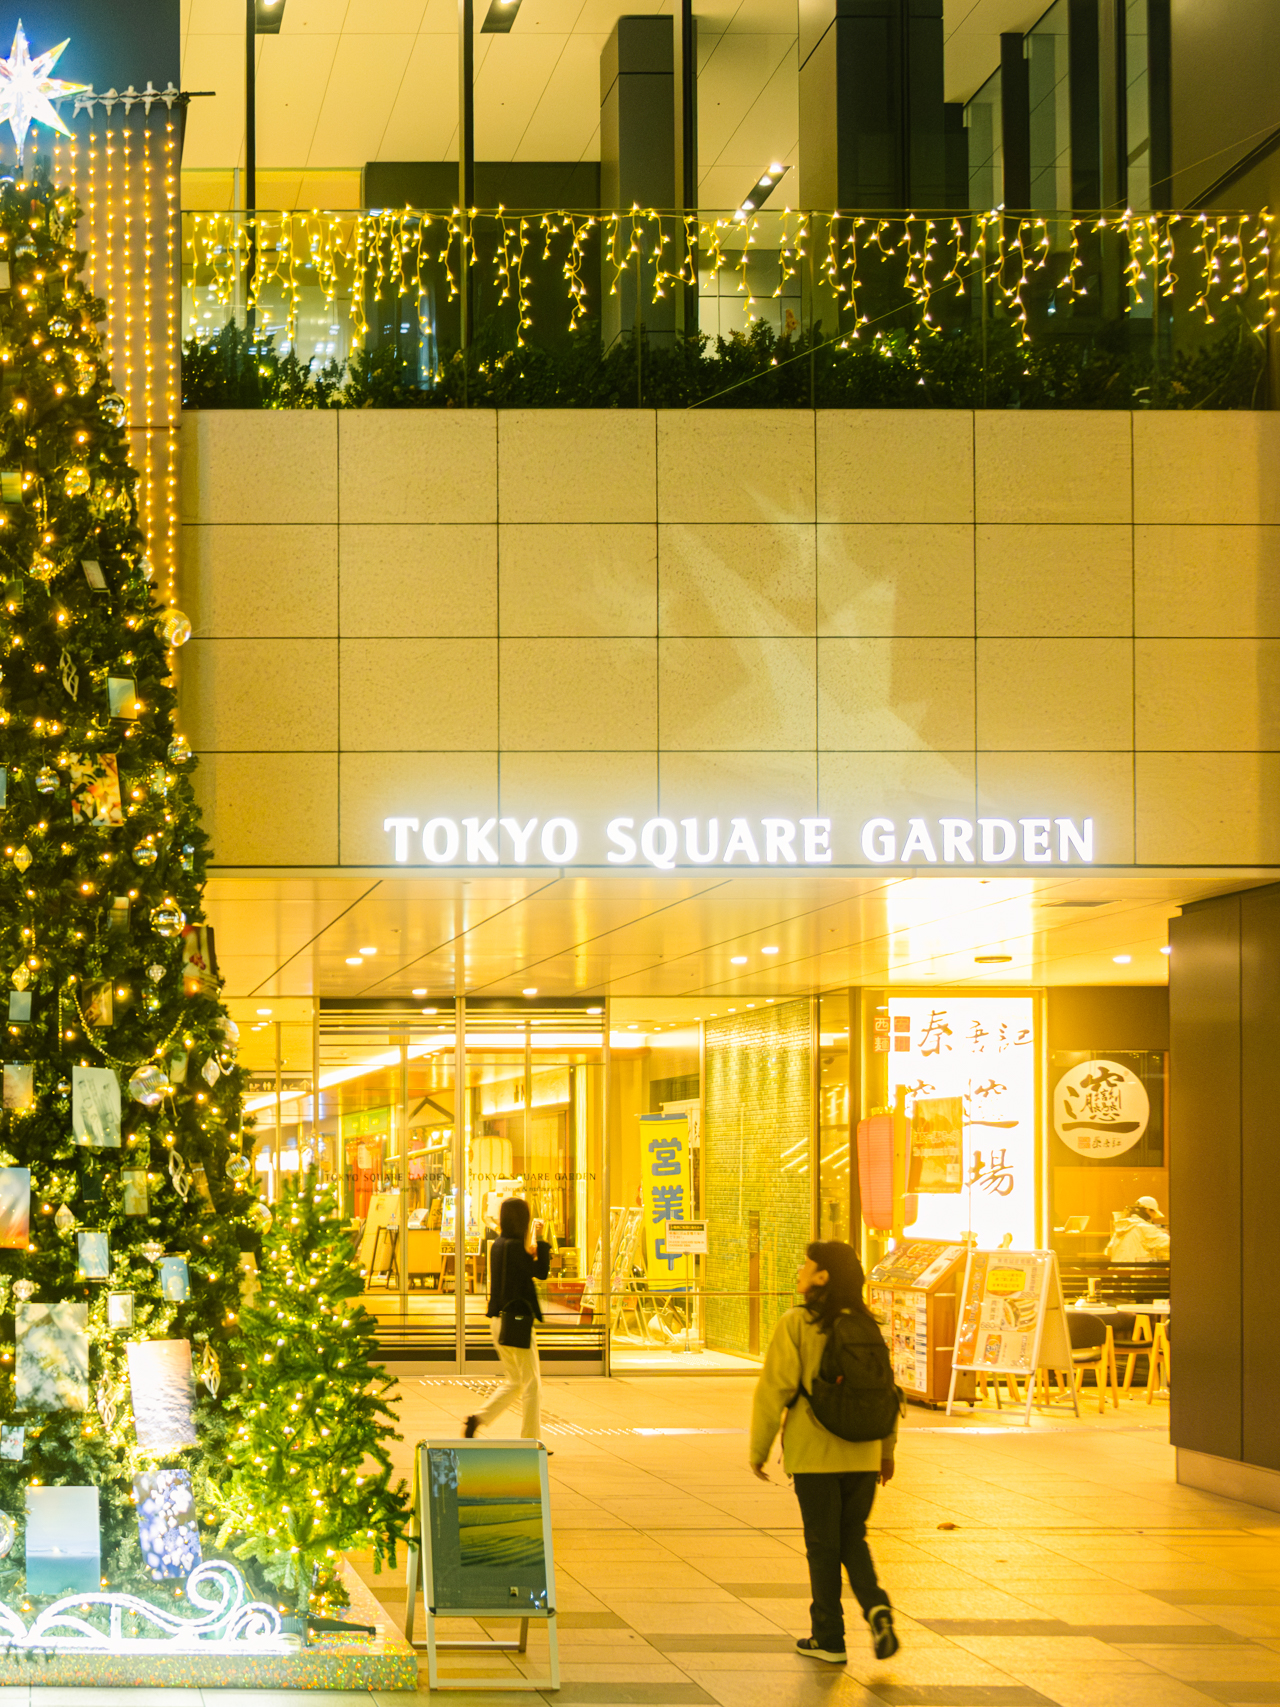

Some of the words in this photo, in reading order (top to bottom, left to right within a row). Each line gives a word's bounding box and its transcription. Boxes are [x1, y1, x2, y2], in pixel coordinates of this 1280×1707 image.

[383, 817, 578, 862] TOKYO
[606, 817, 832, 869] SQUARE
[861, 817, 1093, 862] GARDEN
